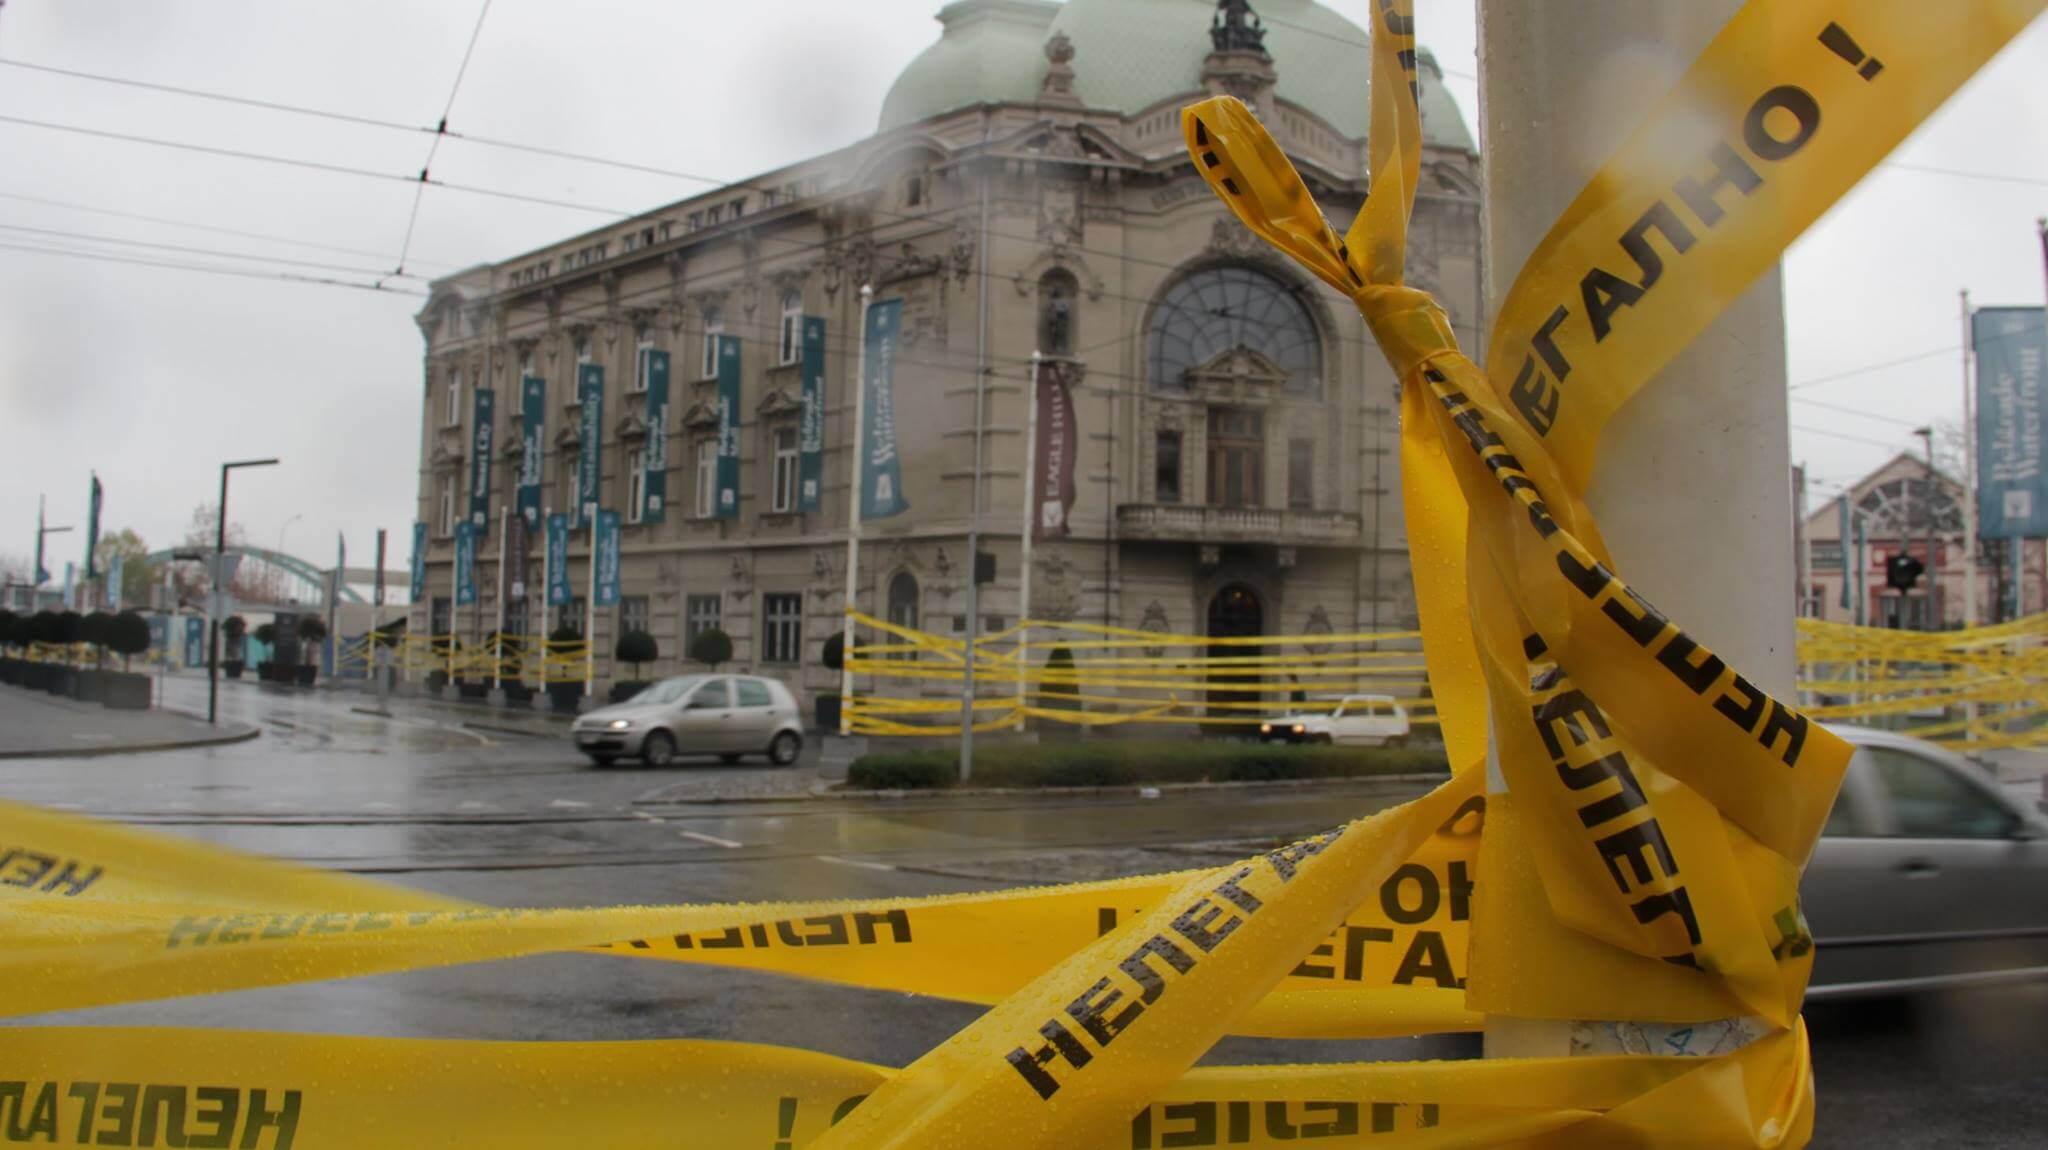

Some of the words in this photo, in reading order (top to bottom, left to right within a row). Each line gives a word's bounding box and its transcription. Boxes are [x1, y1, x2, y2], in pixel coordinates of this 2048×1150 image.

[476, 421, 491, 451] City
[583, 390, 601, 498] Sustainability
[1990, 373, 2015, 481] Belgrade
[2013, 346, 2040, 480] Waterfront
[475, 454, 488, 498] Smart
[1046, 431, 1063, 496] EAGLE
